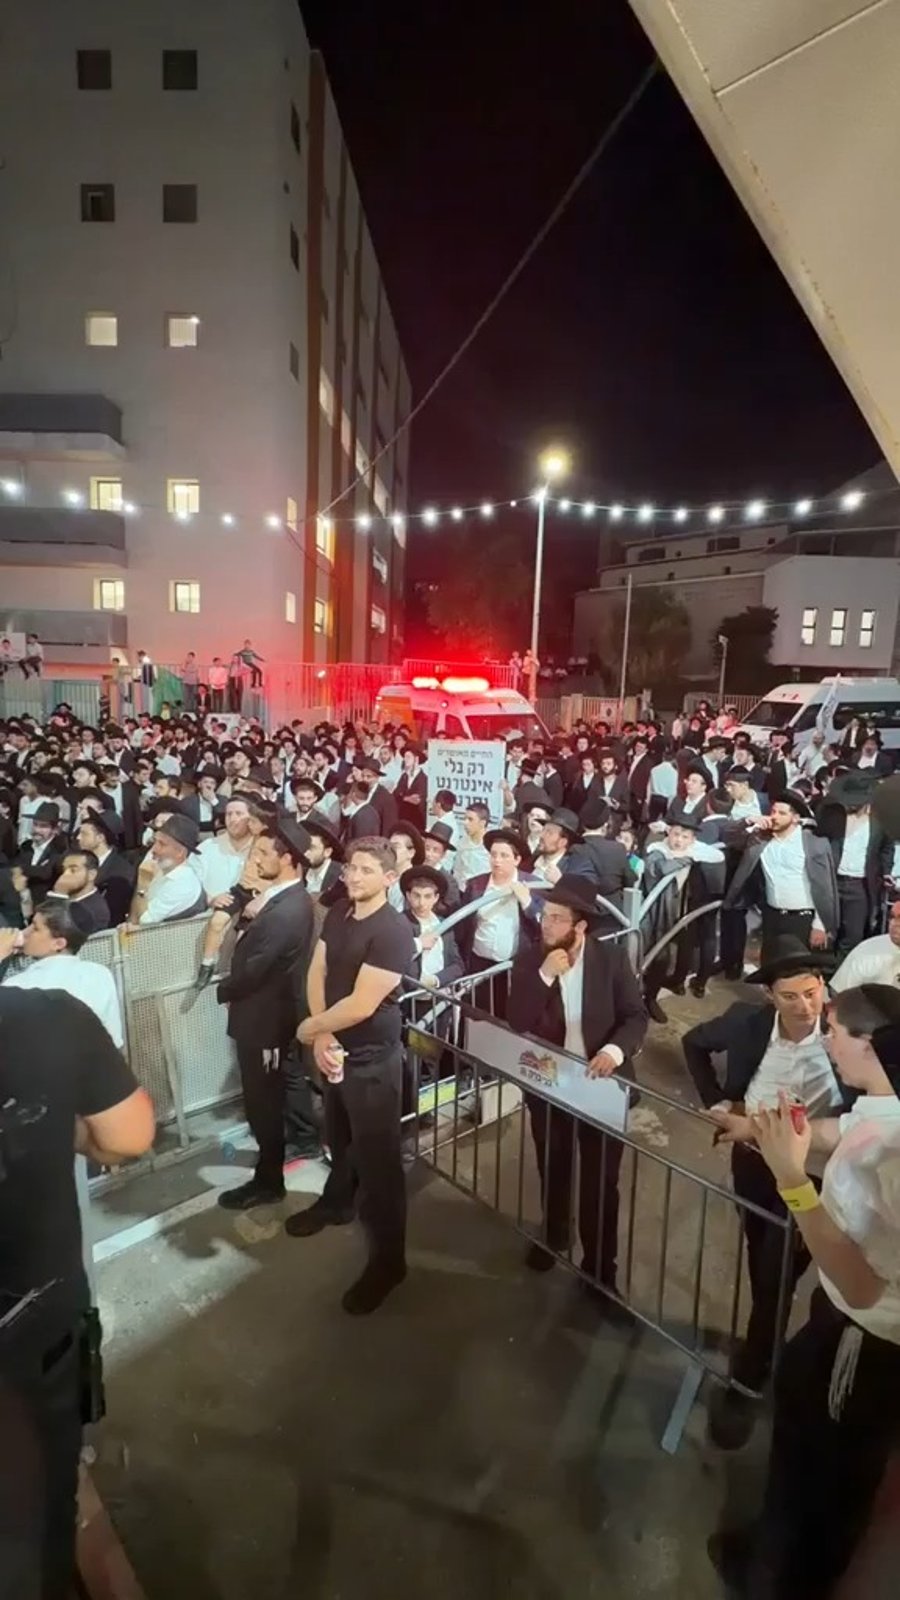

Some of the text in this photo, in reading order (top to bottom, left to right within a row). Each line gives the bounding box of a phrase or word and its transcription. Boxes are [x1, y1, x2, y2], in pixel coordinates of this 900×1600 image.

[445, 758, 484, 777] רק בלי
[436, 776, 493, 793] אינטרנט
